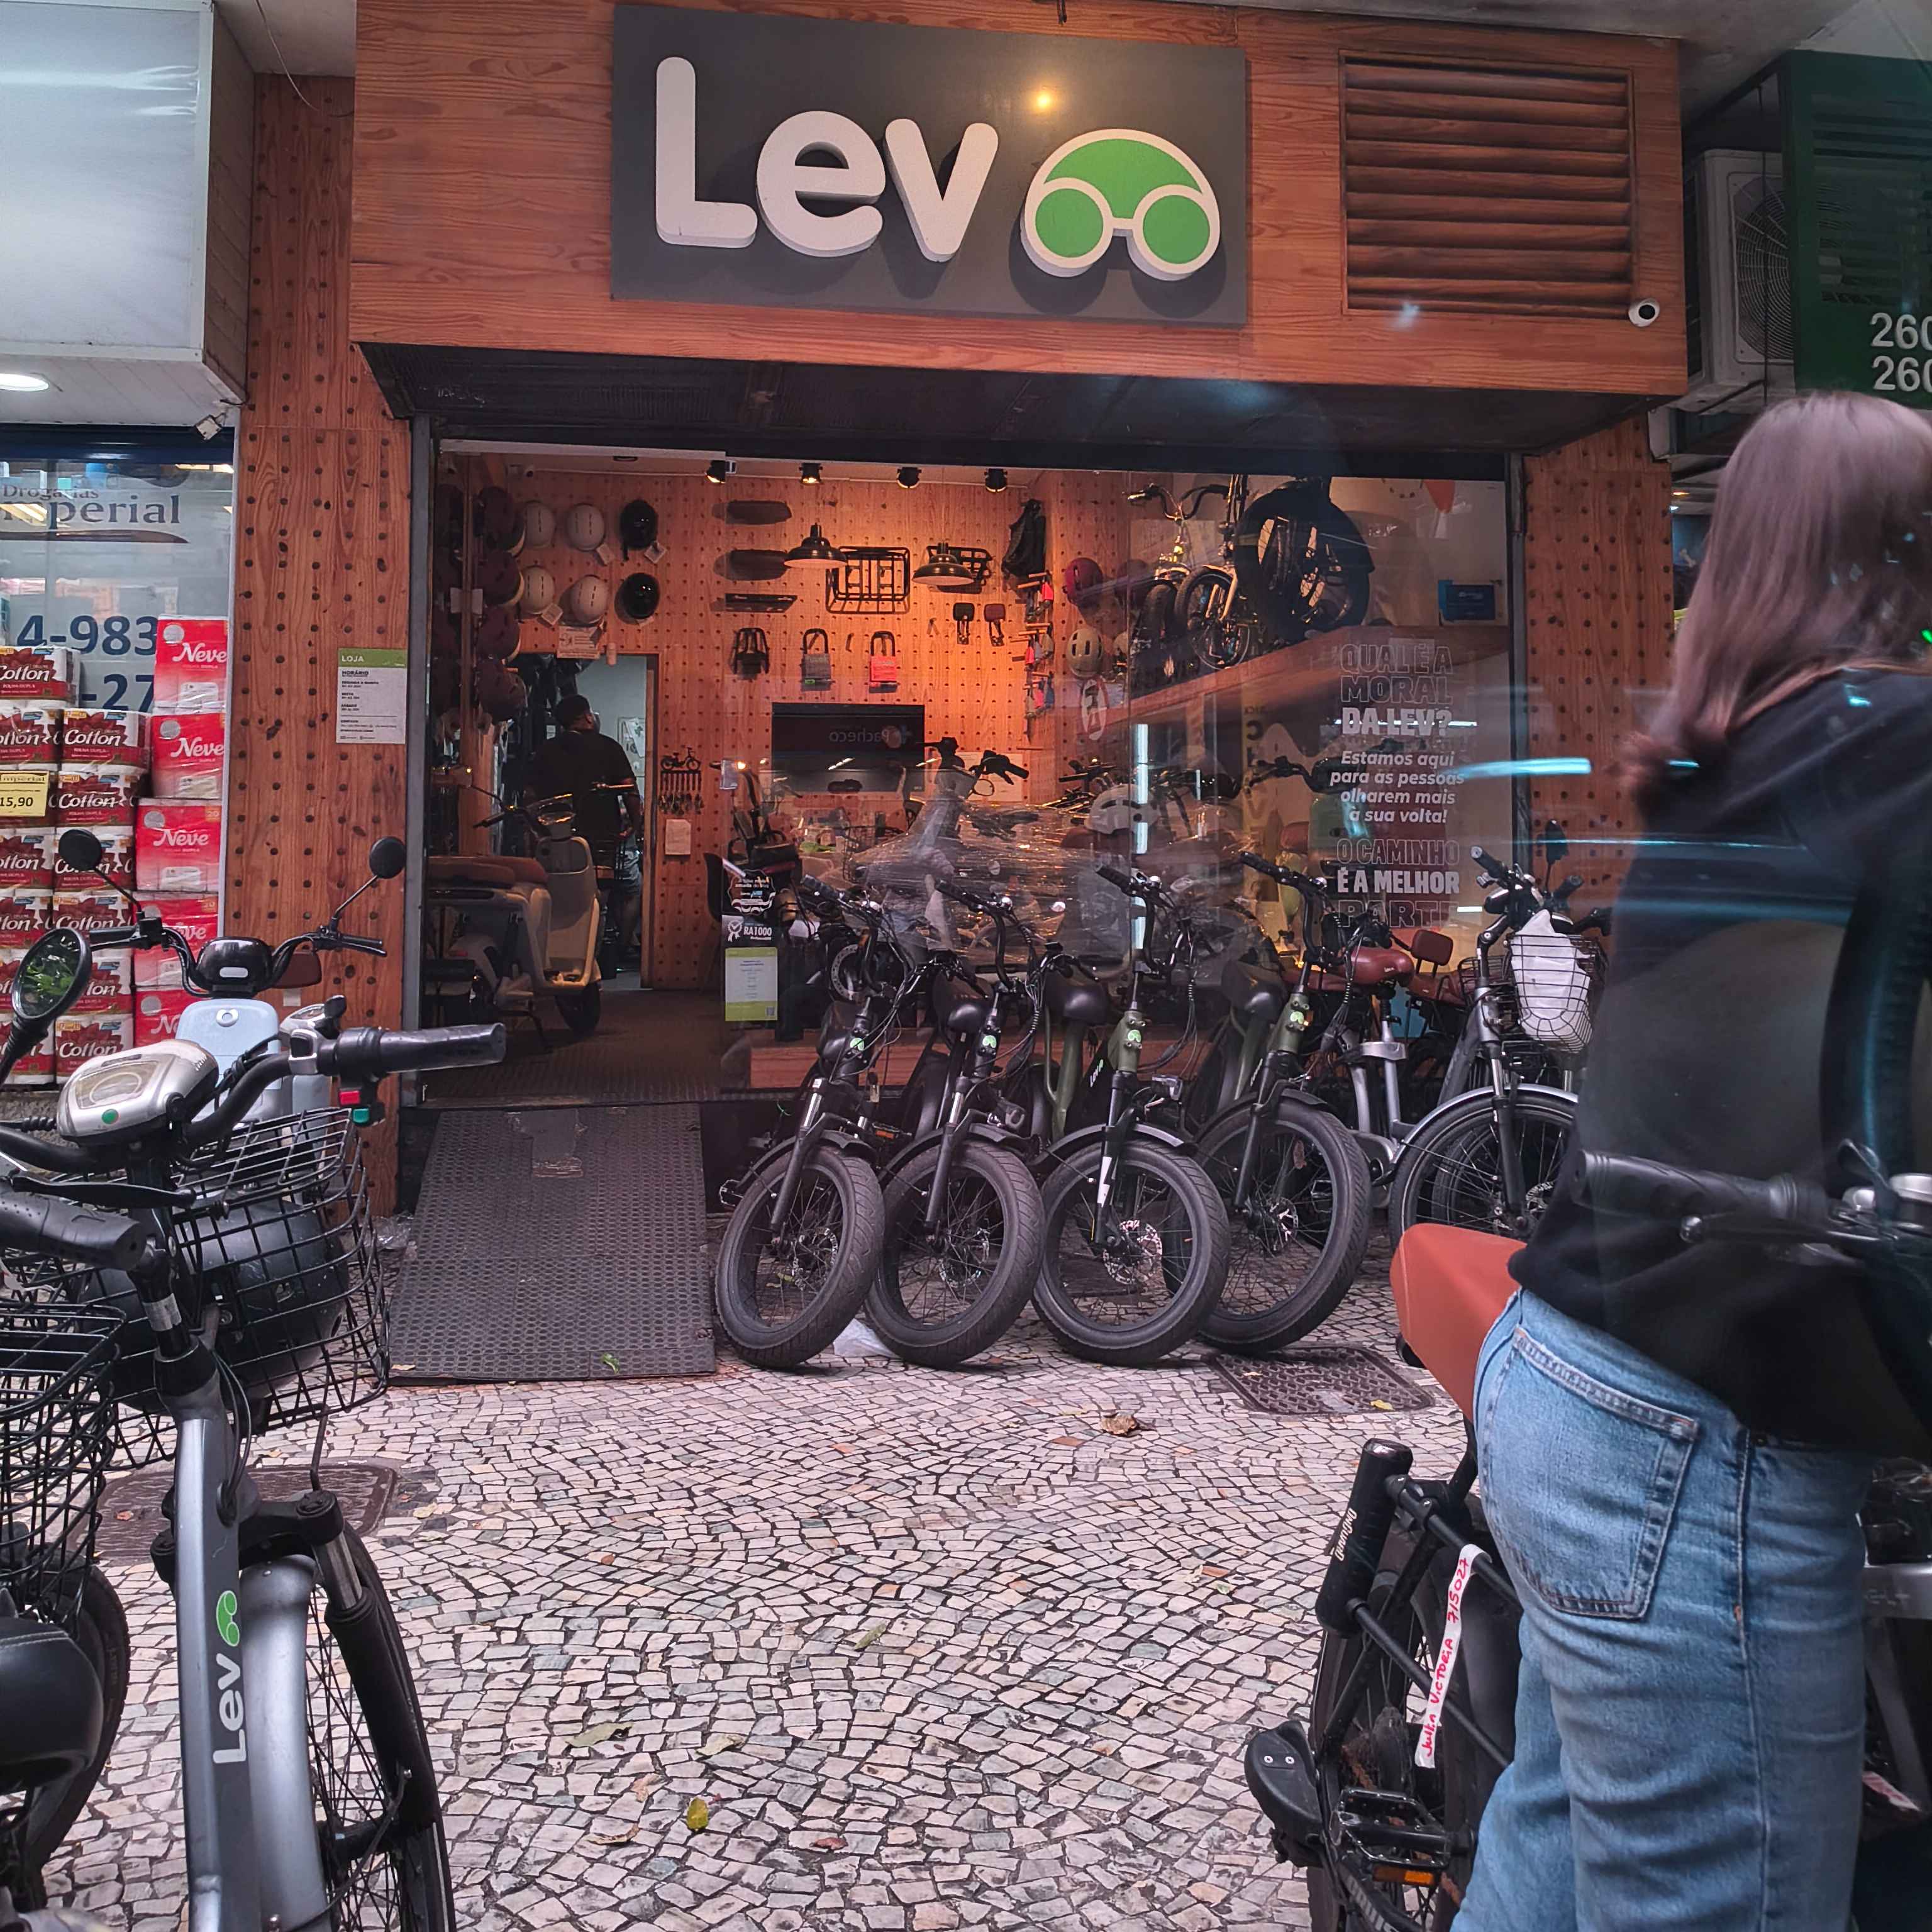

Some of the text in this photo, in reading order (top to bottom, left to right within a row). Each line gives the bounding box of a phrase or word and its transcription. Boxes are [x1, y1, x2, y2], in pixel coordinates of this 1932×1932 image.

[655, 57, 998, 262] Lev
[172, 642, 227, 663] Neve
[1341, 644, 1409, 674] QUAL
[1433, 646, 1453, 674] A
[1340, 675, 1453, 704] MORAL
[1342, 707, 1452, 736] DA LEV?
[64, 729, 121, 747] Cotton
[170, 736, 225, 757] Neve
[1341, 750, 1455, 769] Estamos aqui
[1330, 772, 1465, 787] para as pessoas
[0, 797, 33, 808] 15,90
[58, 793, 116, 808] Cotton
[1340, 787, 1456, 804] olharem mais
[1349, 806, 1448, 823] à sua volta!
[153, 829, 209, 847] Neve
[1337, 838, 1460, 865] O CAMINHO
[1337, 867, 1460, 894] É A MELHOR
[55, 916, 114, 931] Cotton
[743, 926, 772, 936] RA1000
[59, 1042, 118, 1058] Cotton
[1447, 1558, 1469, 1623] 715027
[213, 1653, 247, 1764] Lev
